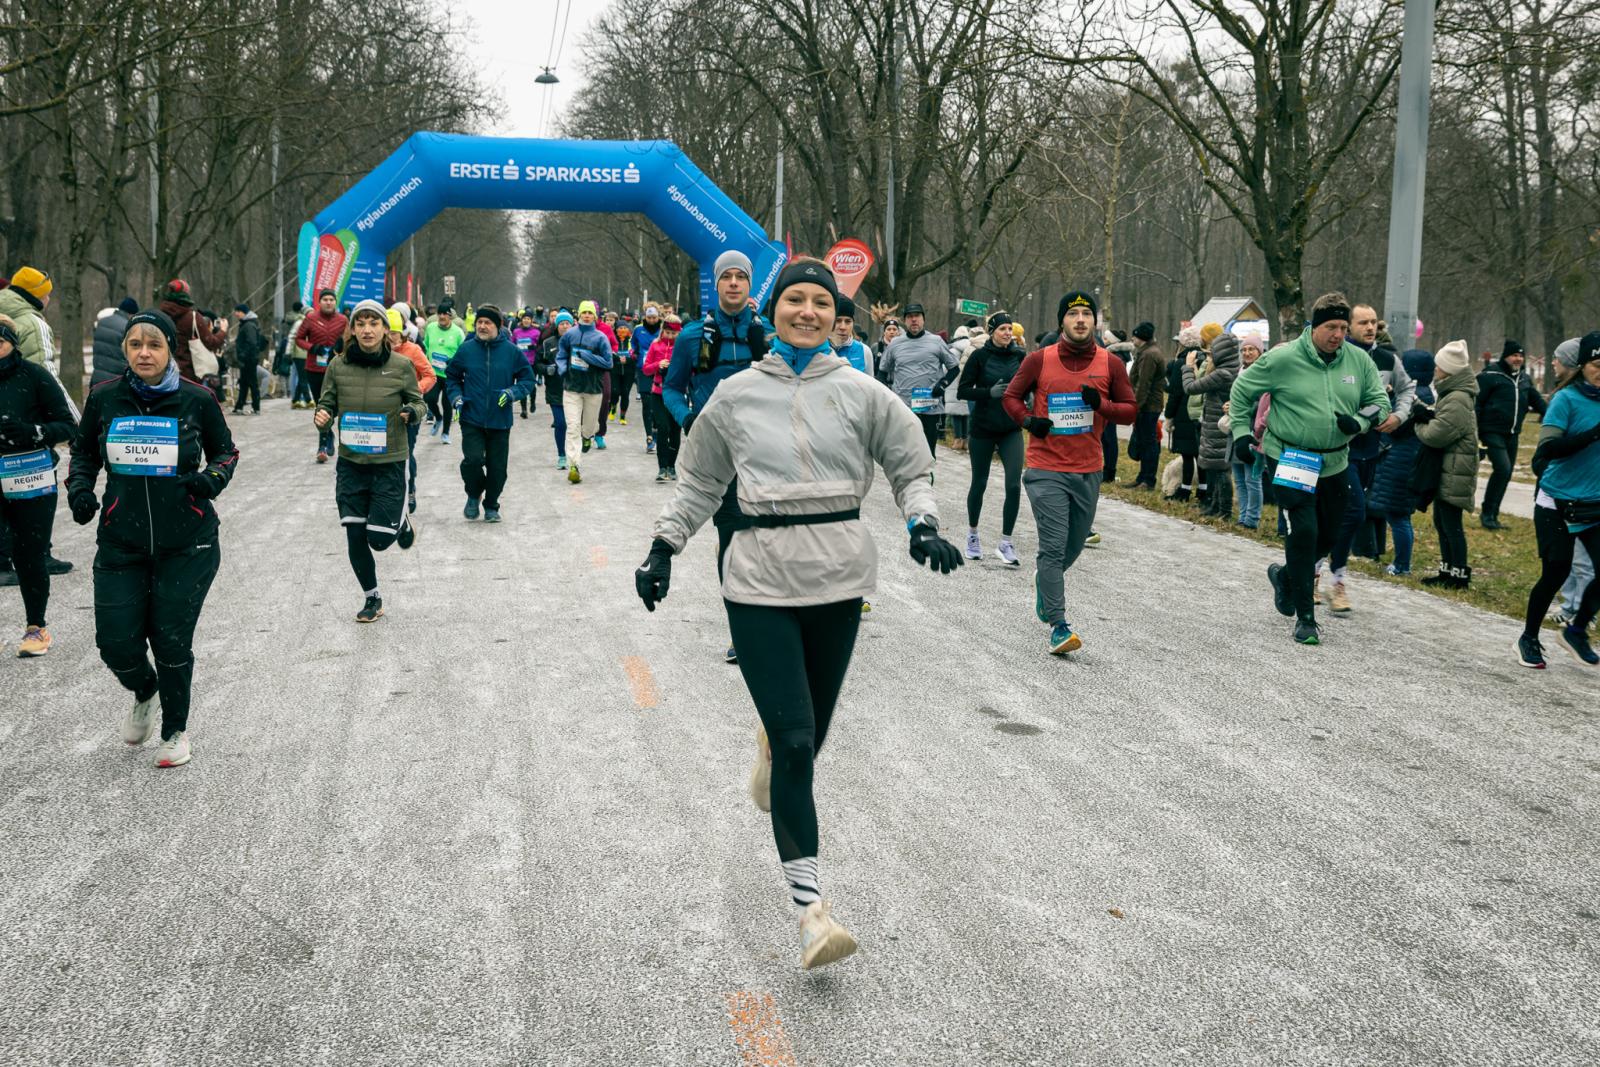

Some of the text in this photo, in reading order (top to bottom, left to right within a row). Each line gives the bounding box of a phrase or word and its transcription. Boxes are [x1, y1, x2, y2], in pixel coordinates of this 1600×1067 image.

[450, 163, 622, 183] ERSTE SPARKASSE
[356, 175, 423, 232] #glaubandich
[667, 184, 728, 243] #glaubandich
[835, 253, 862, 263] Wien
[124, 445, 160, 455] SILVIA
[14, 474, 44, 485] REGINE
